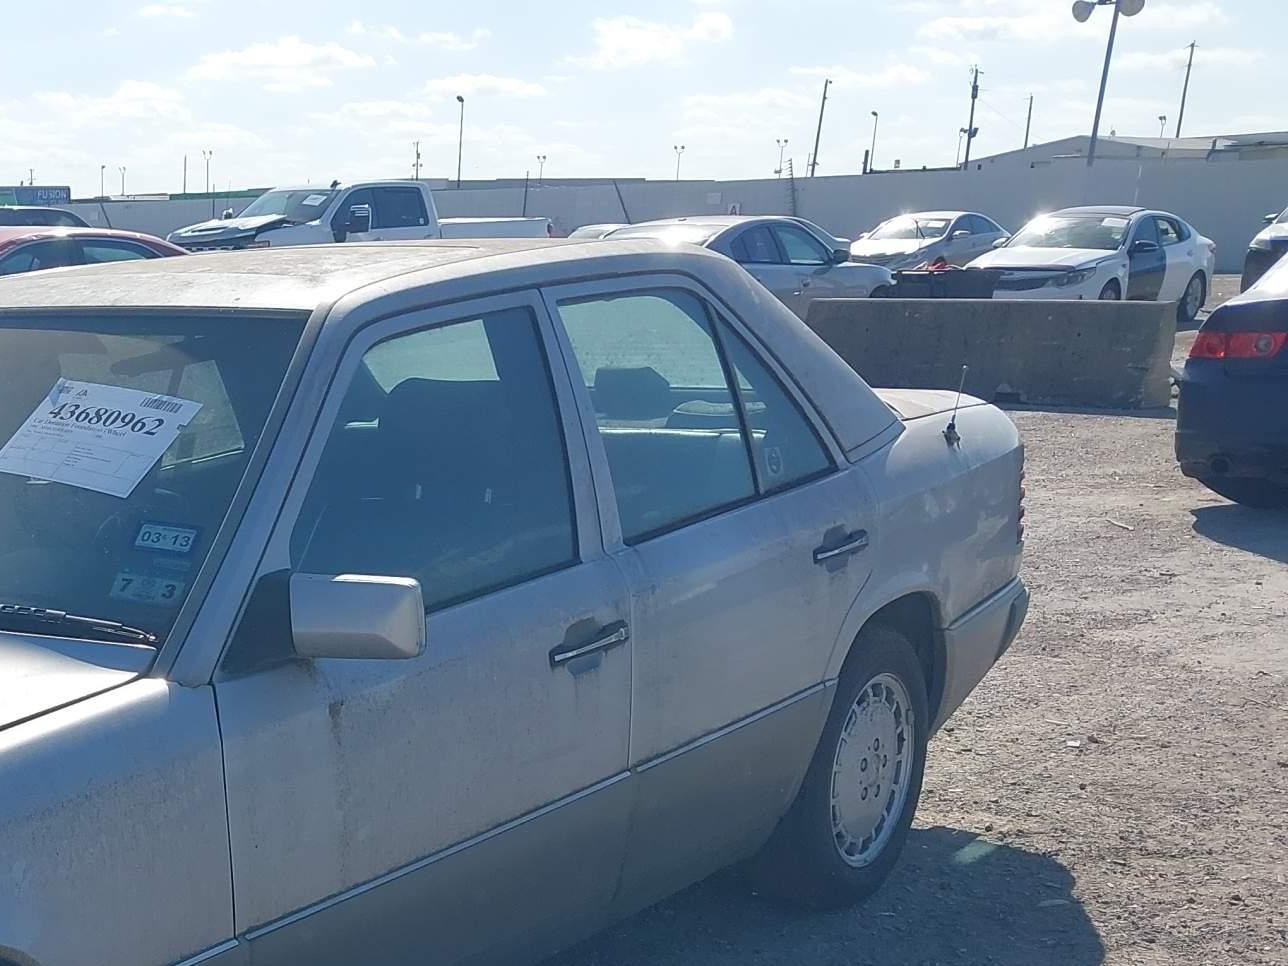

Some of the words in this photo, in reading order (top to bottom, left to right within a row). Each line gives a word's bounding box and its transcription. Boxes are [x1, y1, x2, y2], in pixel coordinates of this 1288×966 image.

[48, 402, 165, 436] 43680962
[141, 531, 162, 543] 03
[172, 534, 191, 547] 13
[119, 578, 133, 592] 7
[161, 584, 176, 599] 3
